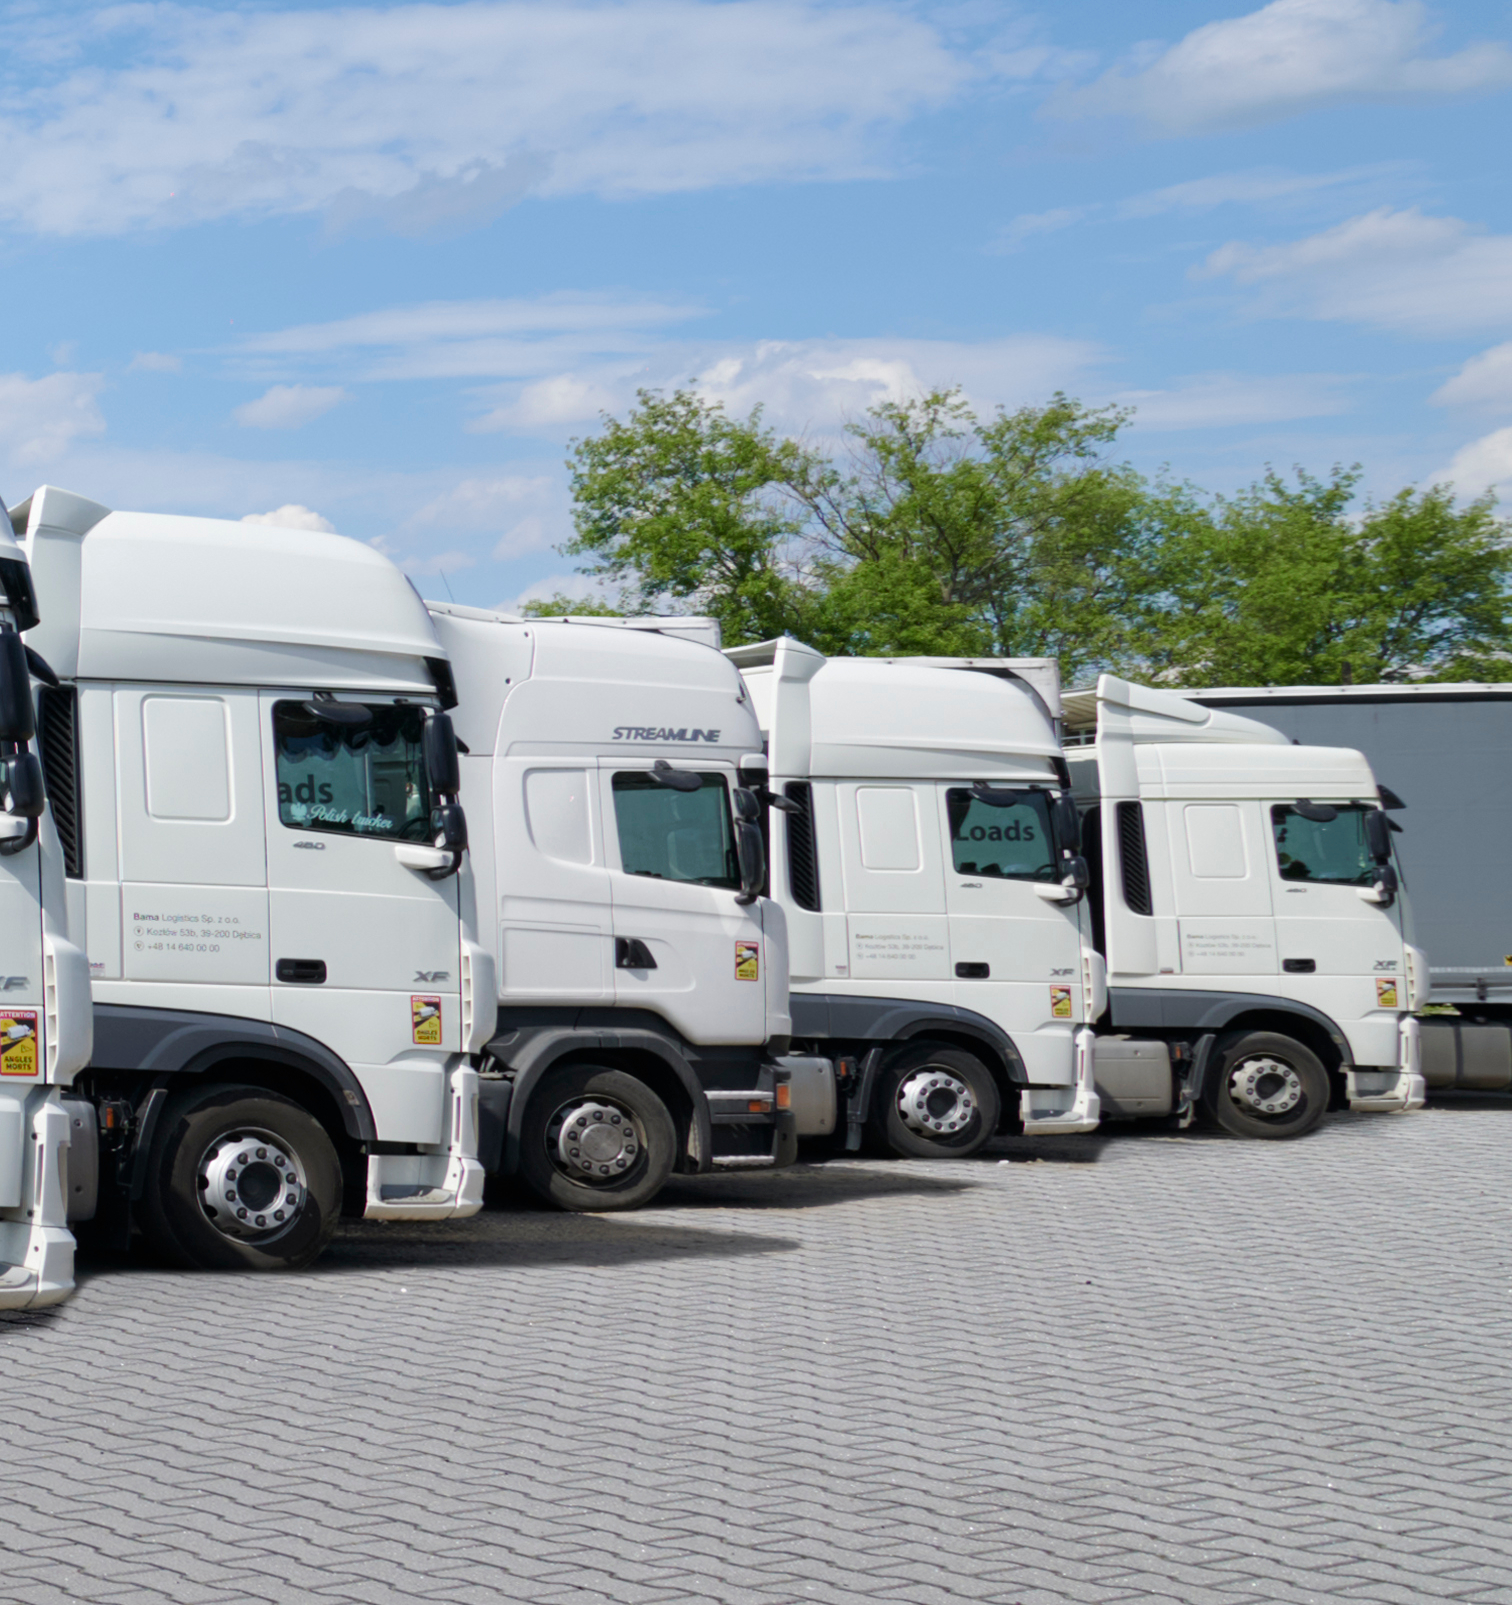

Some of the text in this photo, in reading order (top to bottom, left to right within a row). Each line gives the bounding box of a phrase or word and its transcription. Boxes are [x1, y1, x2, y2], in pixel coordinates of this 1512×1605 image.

[612, 726, 721, 743] STREAMLINE
[133, 912, 159, 922] Bama
[162, 913, 199, 924] Logistics
[200, 929, 230, 939] 39-200
[166, 942, 176, 951] 14
[412, 970, 450, 983] XF
[1049, 968, 1074, 977] XF
[4, 1055, 33, 1063] ANGLES
[5, 1063, 32, 1071] MORTS
